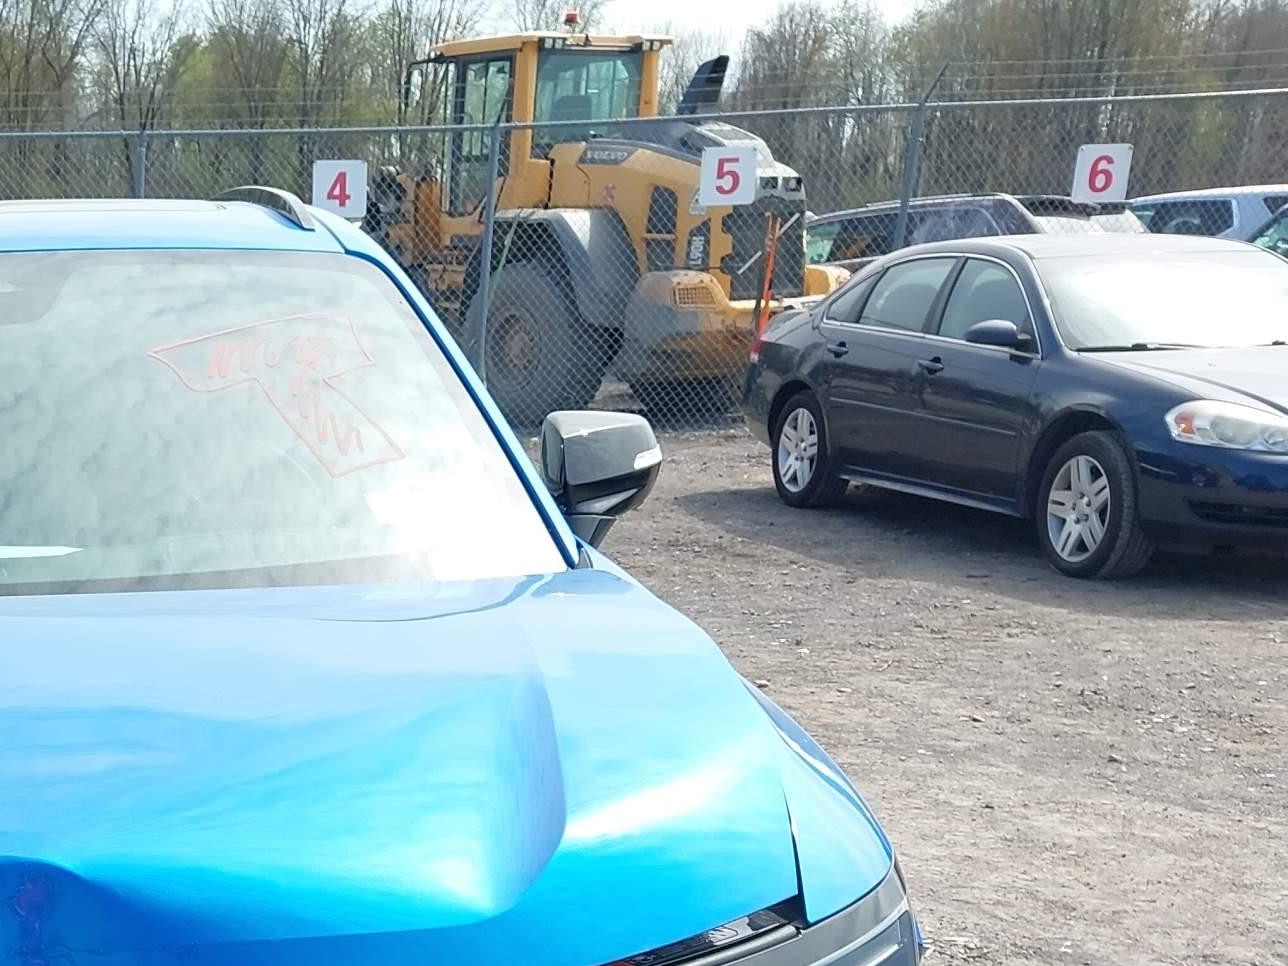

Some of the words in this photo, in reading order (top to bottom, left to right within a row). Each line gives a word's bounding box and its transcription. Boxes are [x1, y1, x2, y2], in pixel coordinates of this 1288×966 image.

[327, 171, 350, 207] 4
[715, 157, 741, 195] 5
[1087, 154, 1114, 193] 6
[689, 236, 705, 265] L90H
